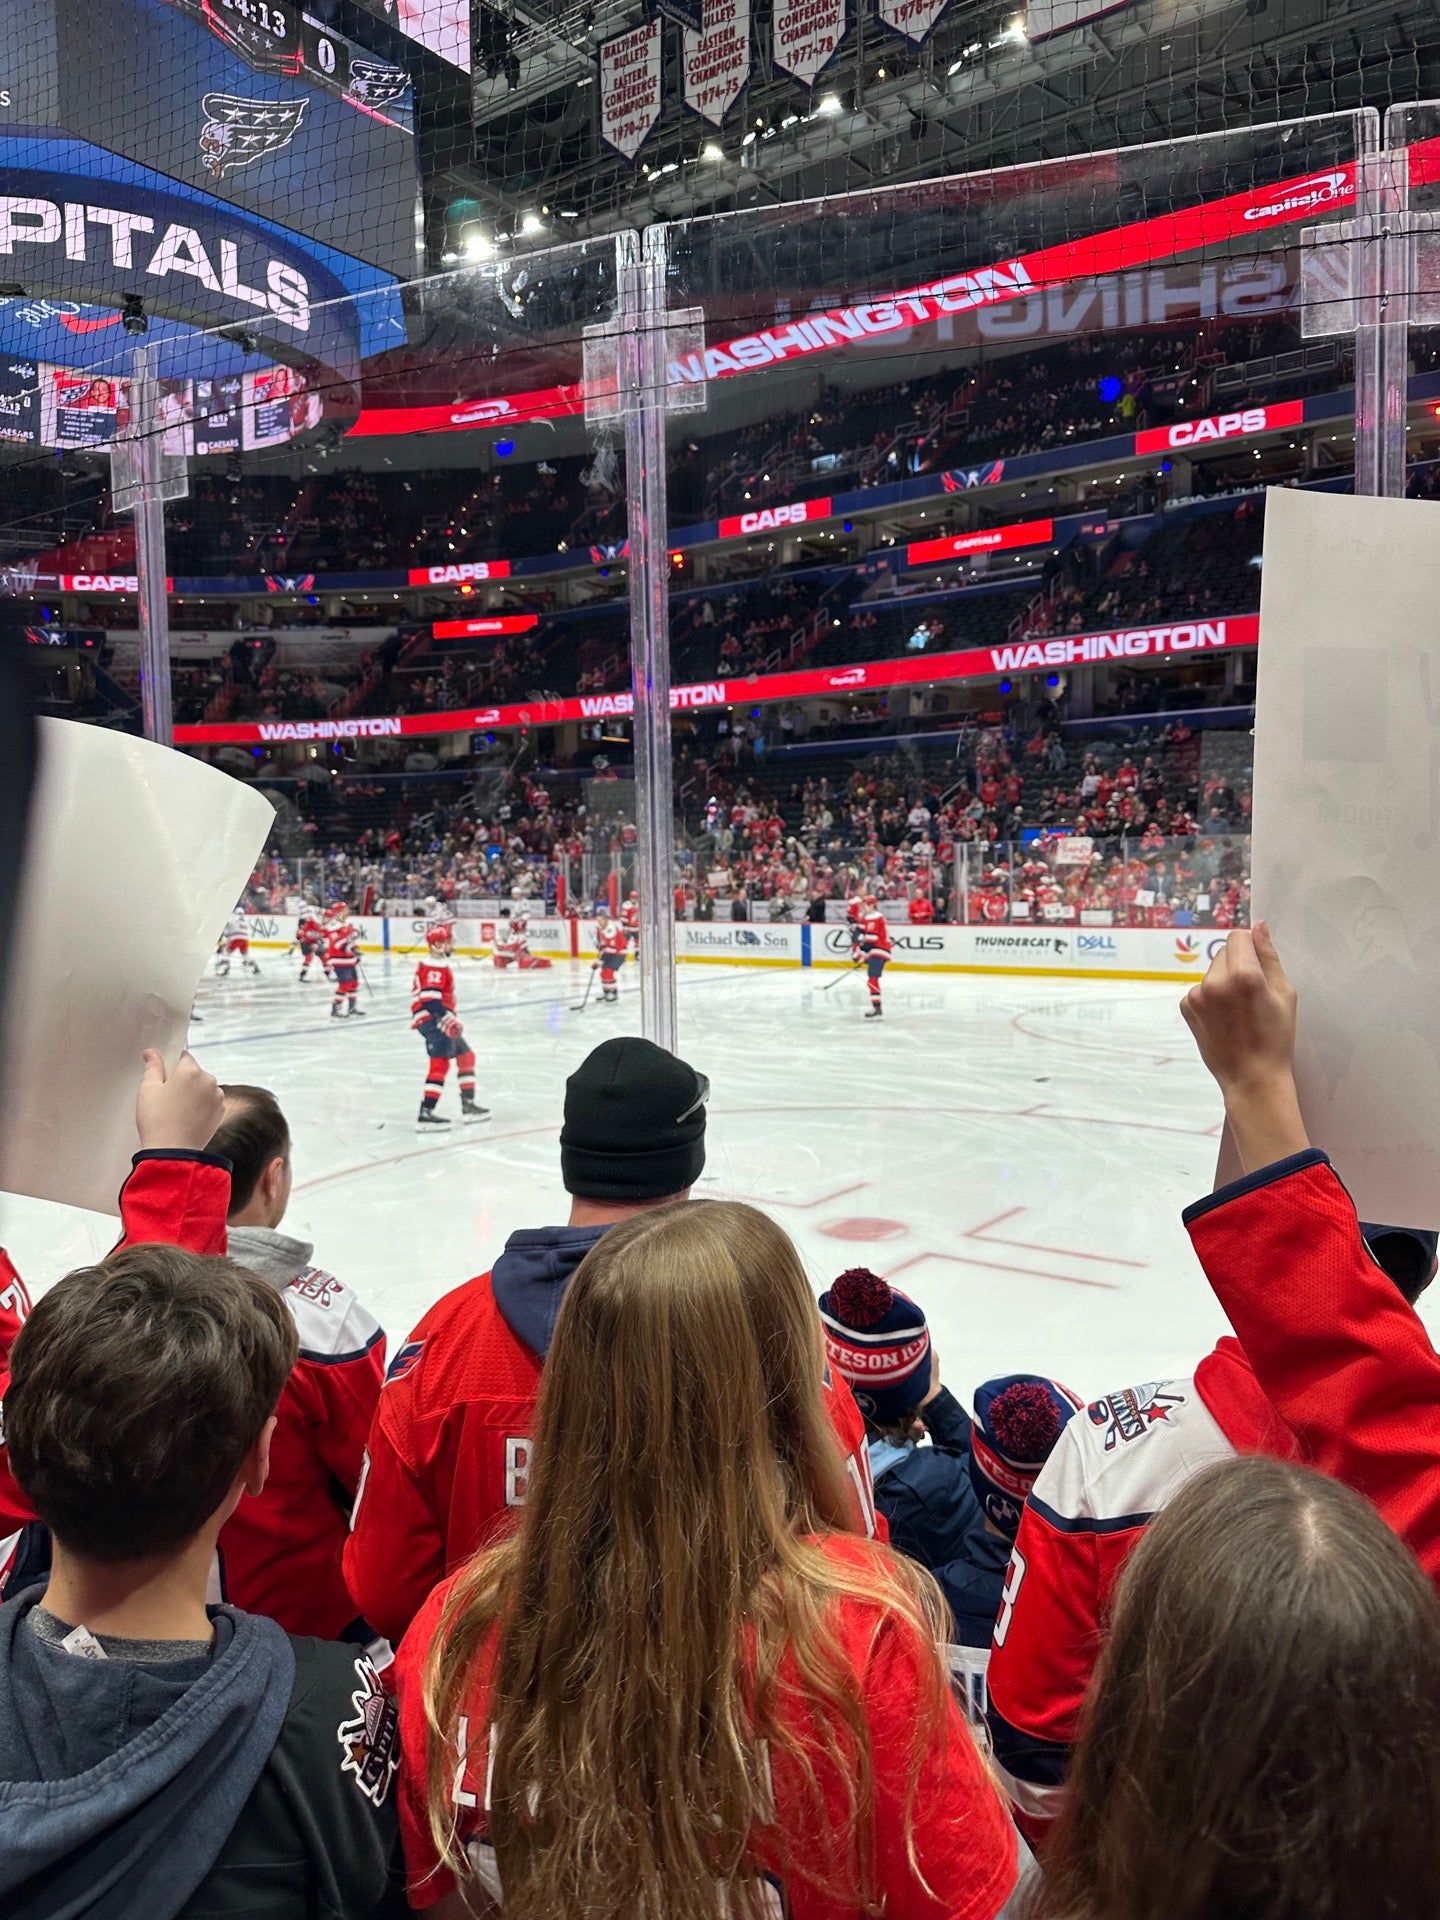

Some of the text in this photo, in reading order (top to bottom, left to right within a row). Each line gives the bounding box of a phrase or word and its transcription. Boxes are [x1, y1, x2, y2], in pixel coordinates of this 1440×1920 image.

[703, 4, 736, 29] ULLETS
[780, 10, 837, 46] CHAMPIONS
[604, 24, 657, 59] BALTIMORE
[697, 25, 736, 51] EASTERN
[787, 36, 833, 67] 1977-78
[317, 38, 336, 74] 0
[613, 44, 649, 71] BULLETS
[688, 36, 747, 72] CONFERENCE
[613, 64, 648, 91] EASTERN
[689, 53, 743, 86] CHAMPIONS
[604, 75, 657, 109] CONFERENCE
[606, 91, 656, 122] CHAMPIONS
[696, 77, 739, 108] 1974-75
[612, 113, 650, 142] 1970-71
[1168, 408, 1266, 447] CAPS
[740, 502, 807, 534] CAPS
[72, 575, 138, 592] CAPS
[429, 562, 489, 584] CAPS
[990, 621, 1226, 672] WASHINGTON
[259, 717, 401, 741] WASHINGTON
[686, 930, 733, 946] Michael
[890, 936, 945, 950] XUS
[974, 936, 1051, 948] THUNDERCAT
[1076, 934, 1116, 949] DELL
